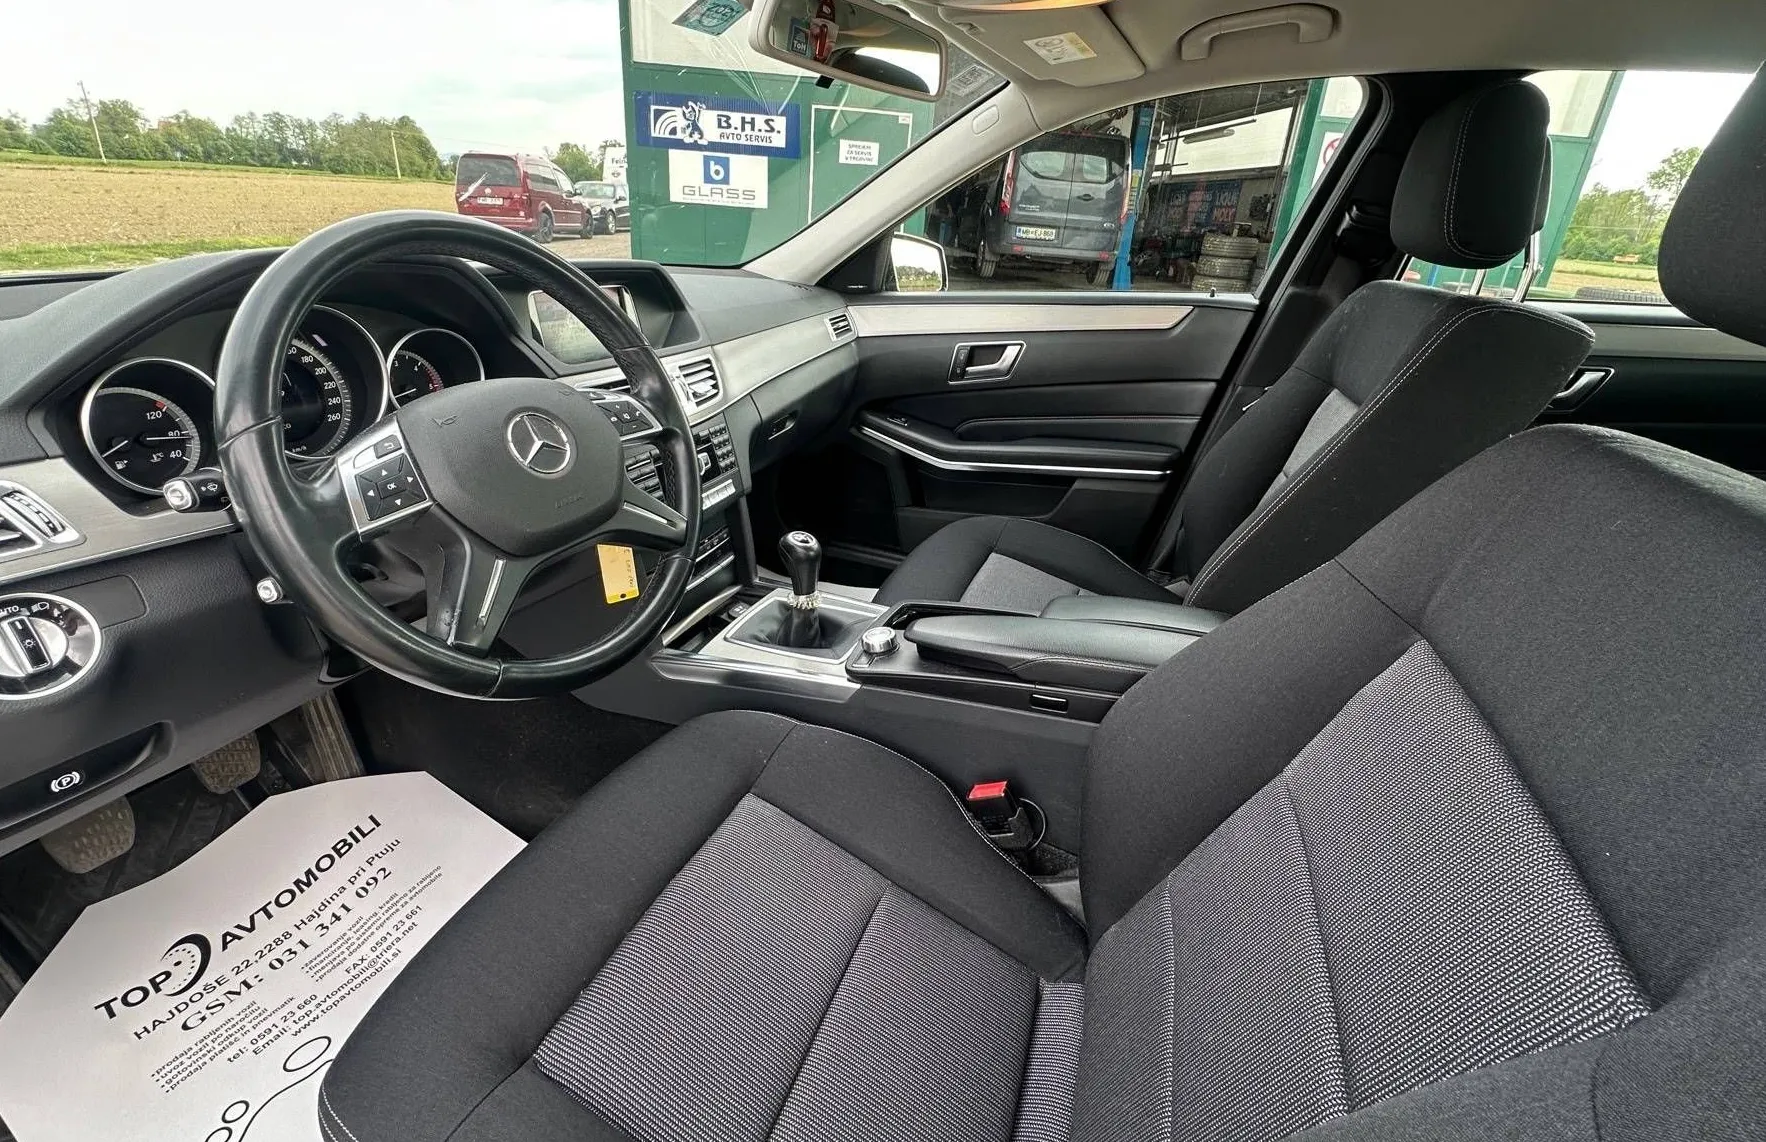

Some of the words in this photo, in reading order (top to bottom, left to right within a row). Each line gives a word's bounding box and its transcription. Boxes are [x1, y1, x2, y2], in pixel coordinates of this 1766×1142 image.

[716, 113, 781, 134] B.H.S.
[719, 132, 742, 141] AVTO
[745, 134, 773, 144] SERVIS
[682, 185, 756, 201] GLASS
[301, 355, 314, 364] 180
[315, 366, 327, 376] 200
[324, 381, 336, 390] 220
[146, 410, 162, 420] 120
[328, 396, 341, 406] 240
[327, 412, 341, 422] 260
[170, 449, 182, 459] 40
[386, 482, 397, 491] OK
[377, 892, 399, 910] kredit
[381, 892, 408, 916] rabljeno
[416, 865, 441, 887] rabljeno
[94, 970, 174, 1019] TOP
[221, 814, 381, 952] AVTOMOBILI
[318, 956, 347, 981] prodaja
[347, 930, 375, 957] dodatne
[375, 907, 401, 931] opreme
[408, 872, 442, 901] avtomobile
[347, 915, 363, 931] vozil
[133, 974, 230, 1040] HAJDOŠE
[230, 930, 293, 977] 22,2288
[293, 884, 347, 931] Hajdina
[348, 865, 366, 886] pri
[365, 838, 401, 867] Ptuju
[180, 969, 264, 1031] GSM:
[268, 938, 312, 970] 031
[314, 902, 355, 937] 341
[354, 866, 393, 899] 092
[344, 953, 370, 974] FAX:
[370, 931, 392, 953] 0591
[392, 918, 406, 932] 23
[404, 904, 422, 920] 661
[251, 1025, 291, 1055] Email:
[292, 921, 418, 1024] top.avtomobili@triera.net
[292, 947, 401, 1036] www.topavtomobili.si
[155, 1046, 193, 1075] prodaja
[194, 1016, 235, 1047] rabljenih
[235, 999, 257, 1016] vozil
[169, 1060, 207, 1090] prodaja
[251, 995, 296, 1030] pnevmatik
[226, 1046, 249, 1063] tel:
[249, 1022, 279, 1045] 0591
[280, 1010, 296, 1023] 23
[296, 993, 318, 1010] 660
[159, 1060, 185, 1079] uvoz
[185, 1042, 209, 1060] vozil
[164, 1045, 216, 1085] gotovinski
[217, 1024, 246, 1046] odkup
[246, 1007, 269, 1024] vozil
